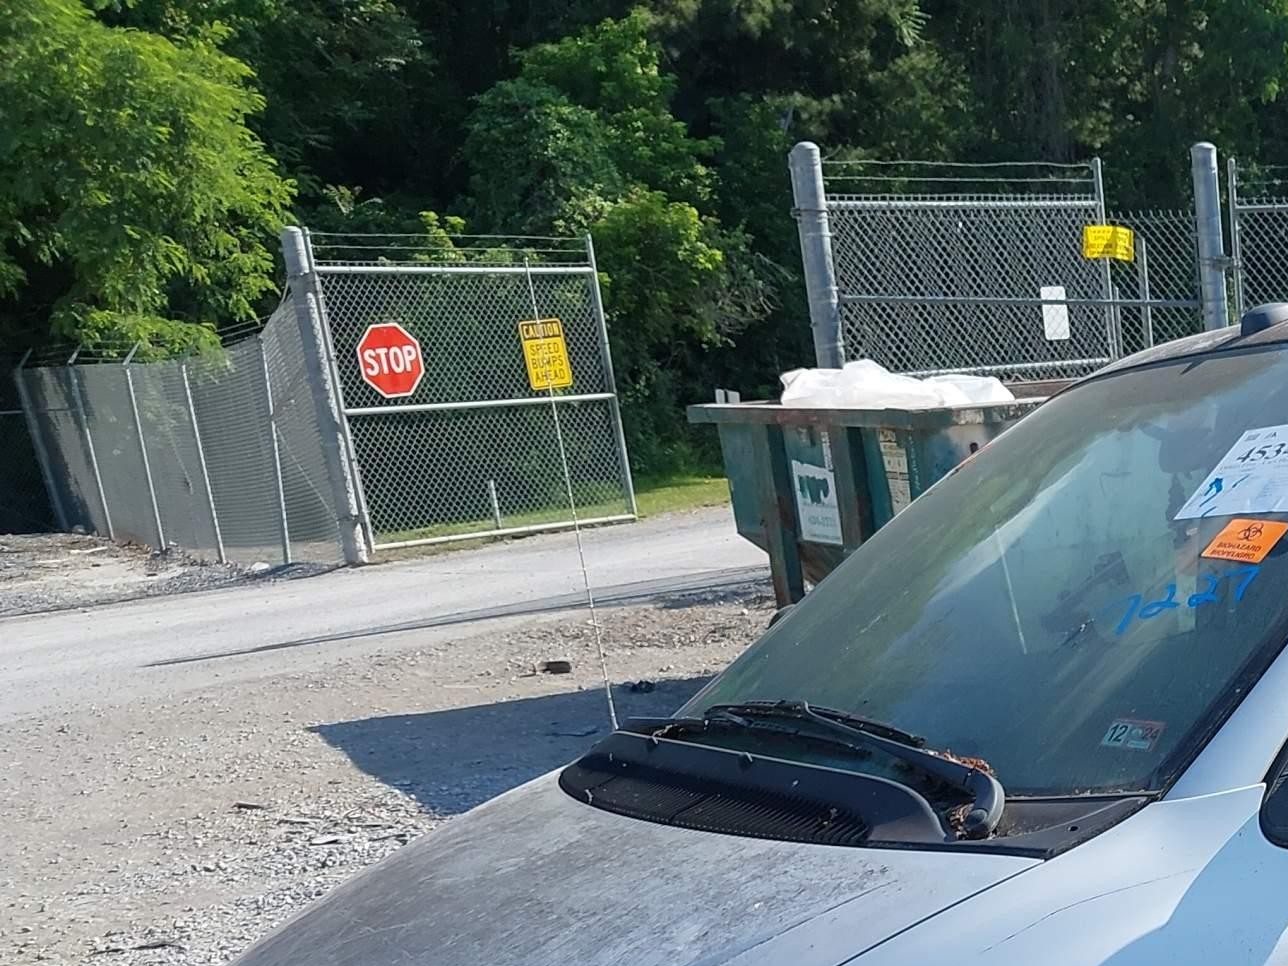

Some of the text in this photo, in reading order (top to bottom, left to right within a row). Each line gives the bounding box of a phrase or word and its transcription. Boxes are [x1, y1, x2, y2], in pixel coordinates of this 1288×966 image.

[523, 323, 560, 338] CAUTION
[530, 342, 559, 356] SPEED
[363, 345, 417, 376] STOP
[535, 368, 566, 382] AHEAD
[1217, 541, 1263, 552] BIOHAZARD
[1107, 724, 1128, 742] 12
